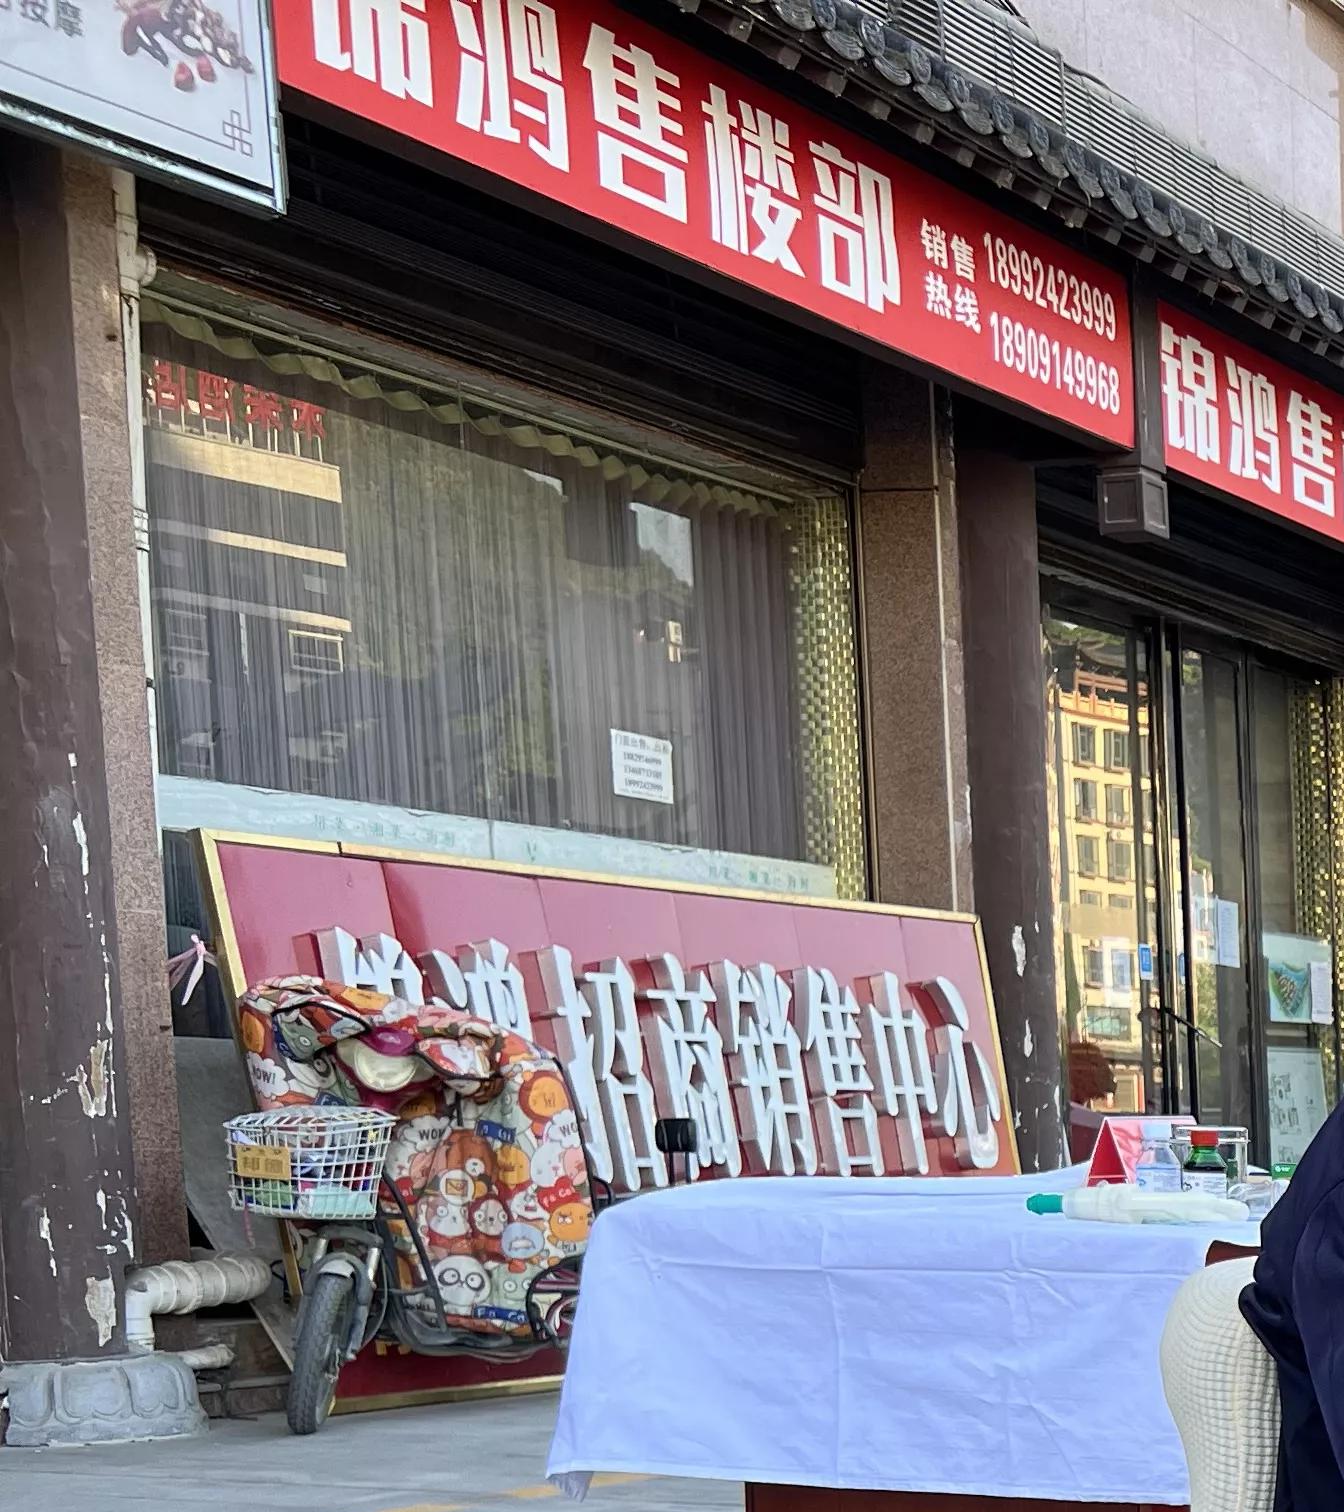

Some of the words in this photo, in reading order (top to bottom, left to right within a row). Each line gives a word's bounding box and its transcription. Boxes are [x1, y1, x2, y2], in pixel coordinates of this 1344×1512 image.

[0, 0, 83, 38] 按摩
[920, 217, 976, 283] 销售
[983, 231, 1116, 342] 18992423999
[925, 270, 982, 334] 热线
[989, 311, 1120, 415] 18909149968
